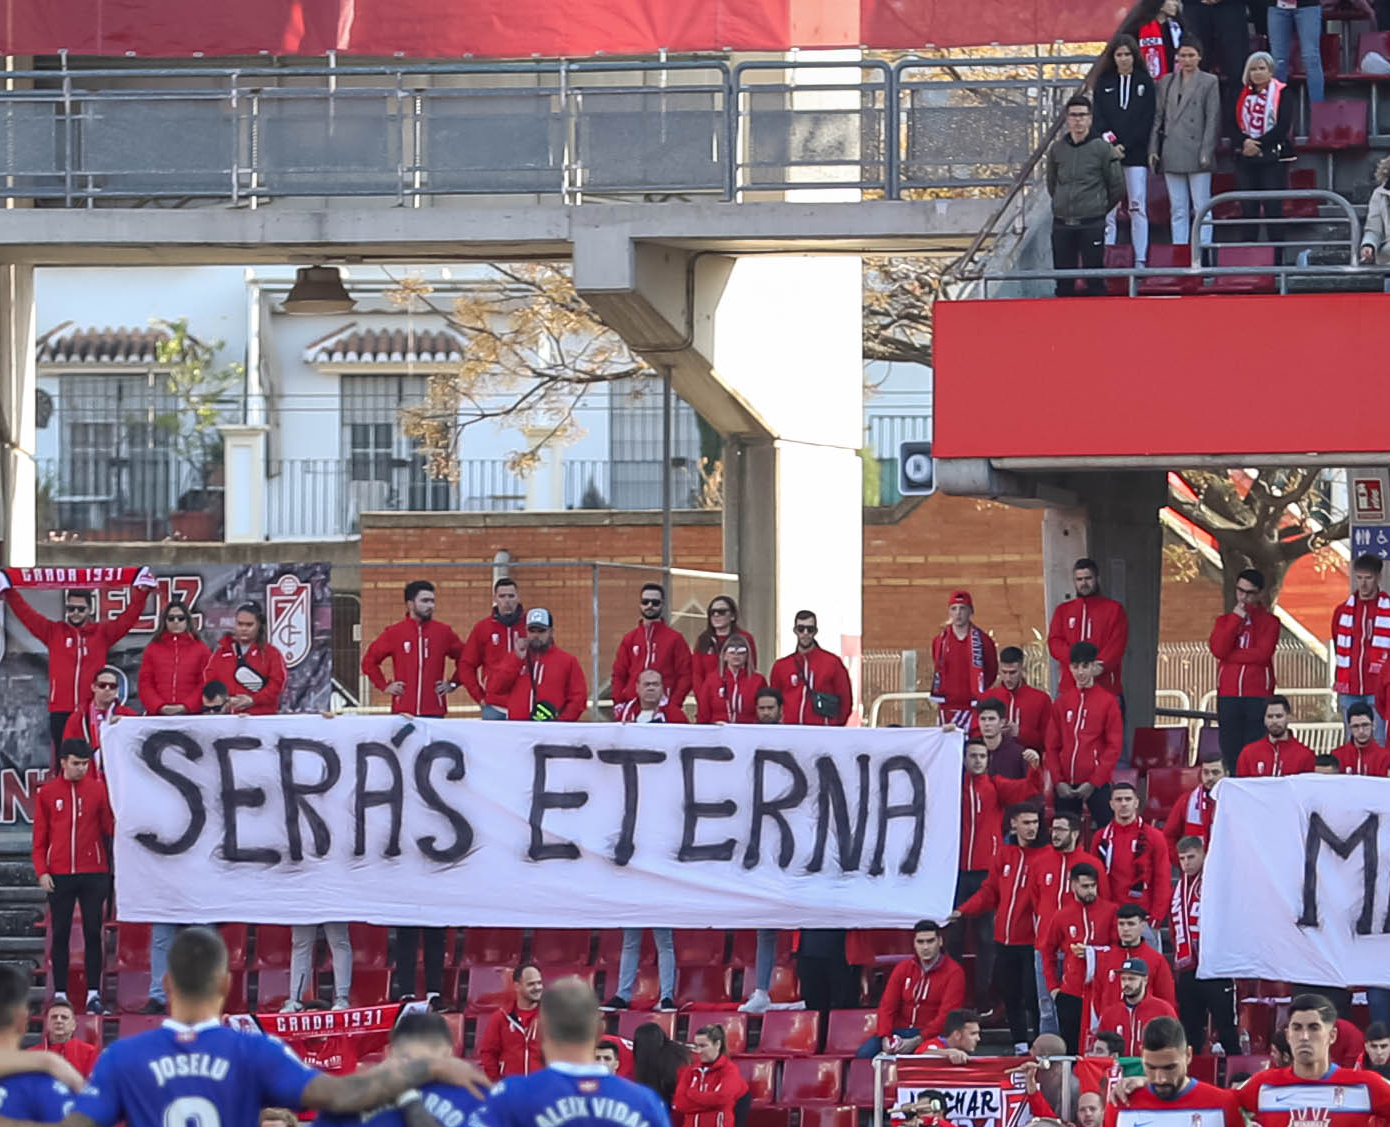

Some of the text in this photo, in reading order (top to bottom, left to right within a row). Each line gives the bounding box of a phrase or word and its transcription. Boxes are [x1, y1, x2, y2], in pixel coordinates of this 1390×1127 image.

[133, 721, 927, 876] SERÁS ETERNA
[344, 1009, 382, 1028] 1931
[149, 1053, 230, 1087] JOSELU
